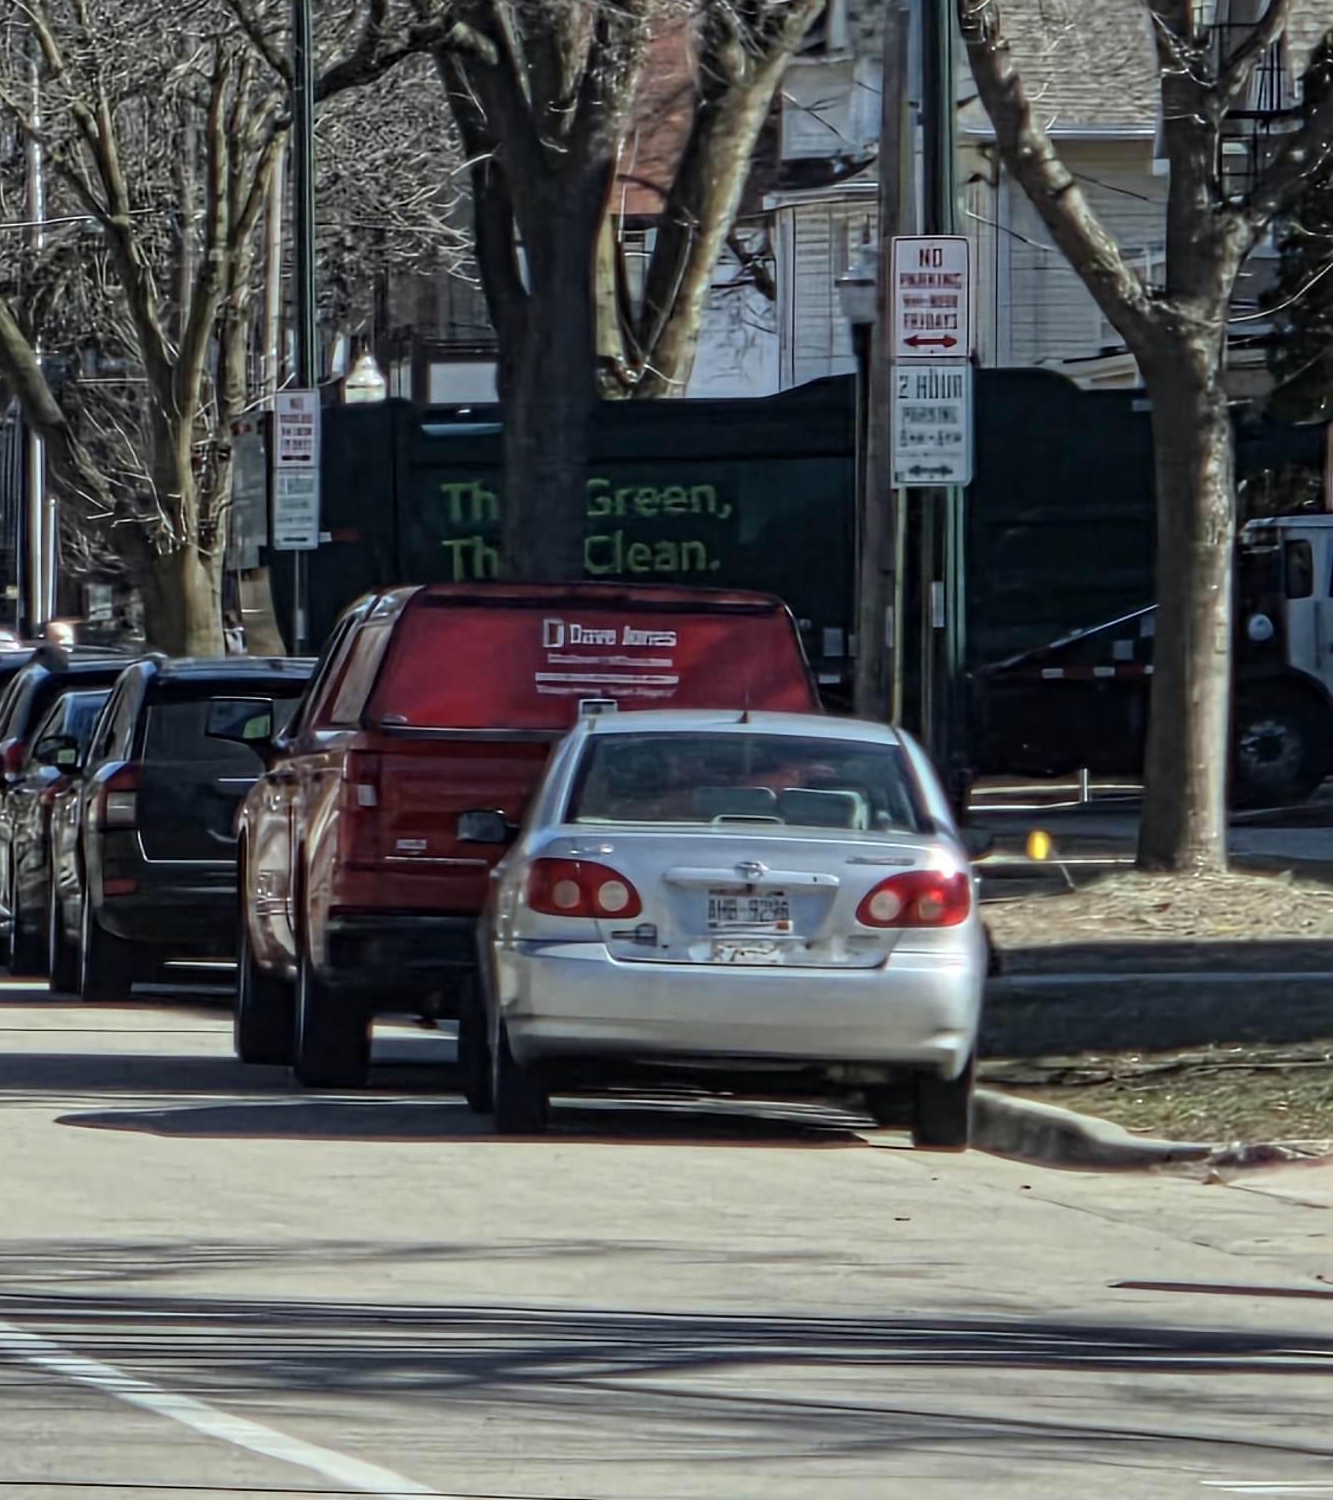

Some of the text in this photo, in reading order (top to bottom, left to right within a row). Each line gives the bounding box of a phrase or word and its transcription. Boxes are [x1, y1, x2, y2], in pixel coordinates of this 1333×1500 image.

[919, 248, 943, 268] NO
[899, 273, 962, 289] PARKING
[898, 374, 962, 399] 2 HOUR
[583, 530, 721, 574] Clean.
[569, 624, 617, 645] Dave
